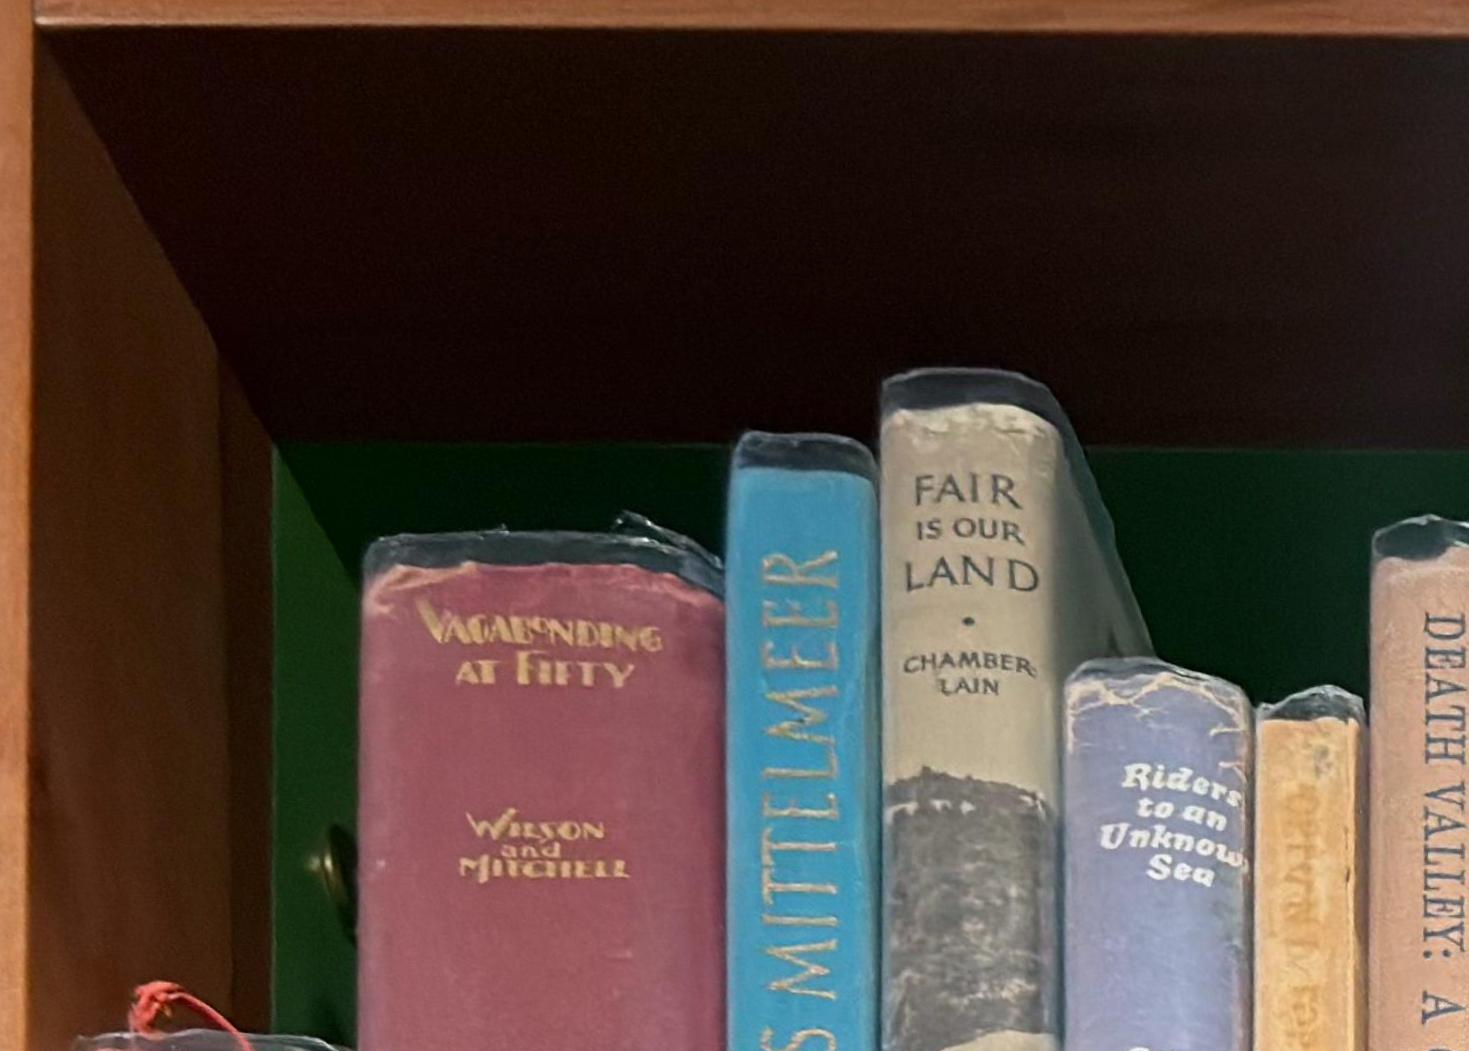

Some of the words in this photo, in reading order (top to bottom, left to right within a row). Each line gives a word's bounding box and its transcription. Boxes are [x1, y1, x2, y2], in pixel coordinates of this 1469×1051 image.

[914, 472, 1023, 510] FAIR
[916, 518, 943, 541] IS
[952, 516, 1025, 546] OUR
[904, 554, 1040, 593] LAND
[415, 598, 663, 652] VAGABONDING
[455, 659, 500, 685] AT
[515, 650, 635, 688] FIFTY
[937, 677, 1000, 697] LAIN
[1423, 611, 1467, 766] DEATH
[762, 549, 839, 1002] MITTELMEER
[1121, 762, 1242, 807] Riders
[465, 807, 605, 843] WILSON
[1137, 797, 1175, 819] to
[1181, 805, 1228, 832] an
[459, 854, 631, 884] MITCHELL
[500, 842, 561, 860] and
[1422, 778, 1467, 961] VALLEY:
[1146, 853, 1215, 888] Sea
[1421, 989, 1466, 1025] A
